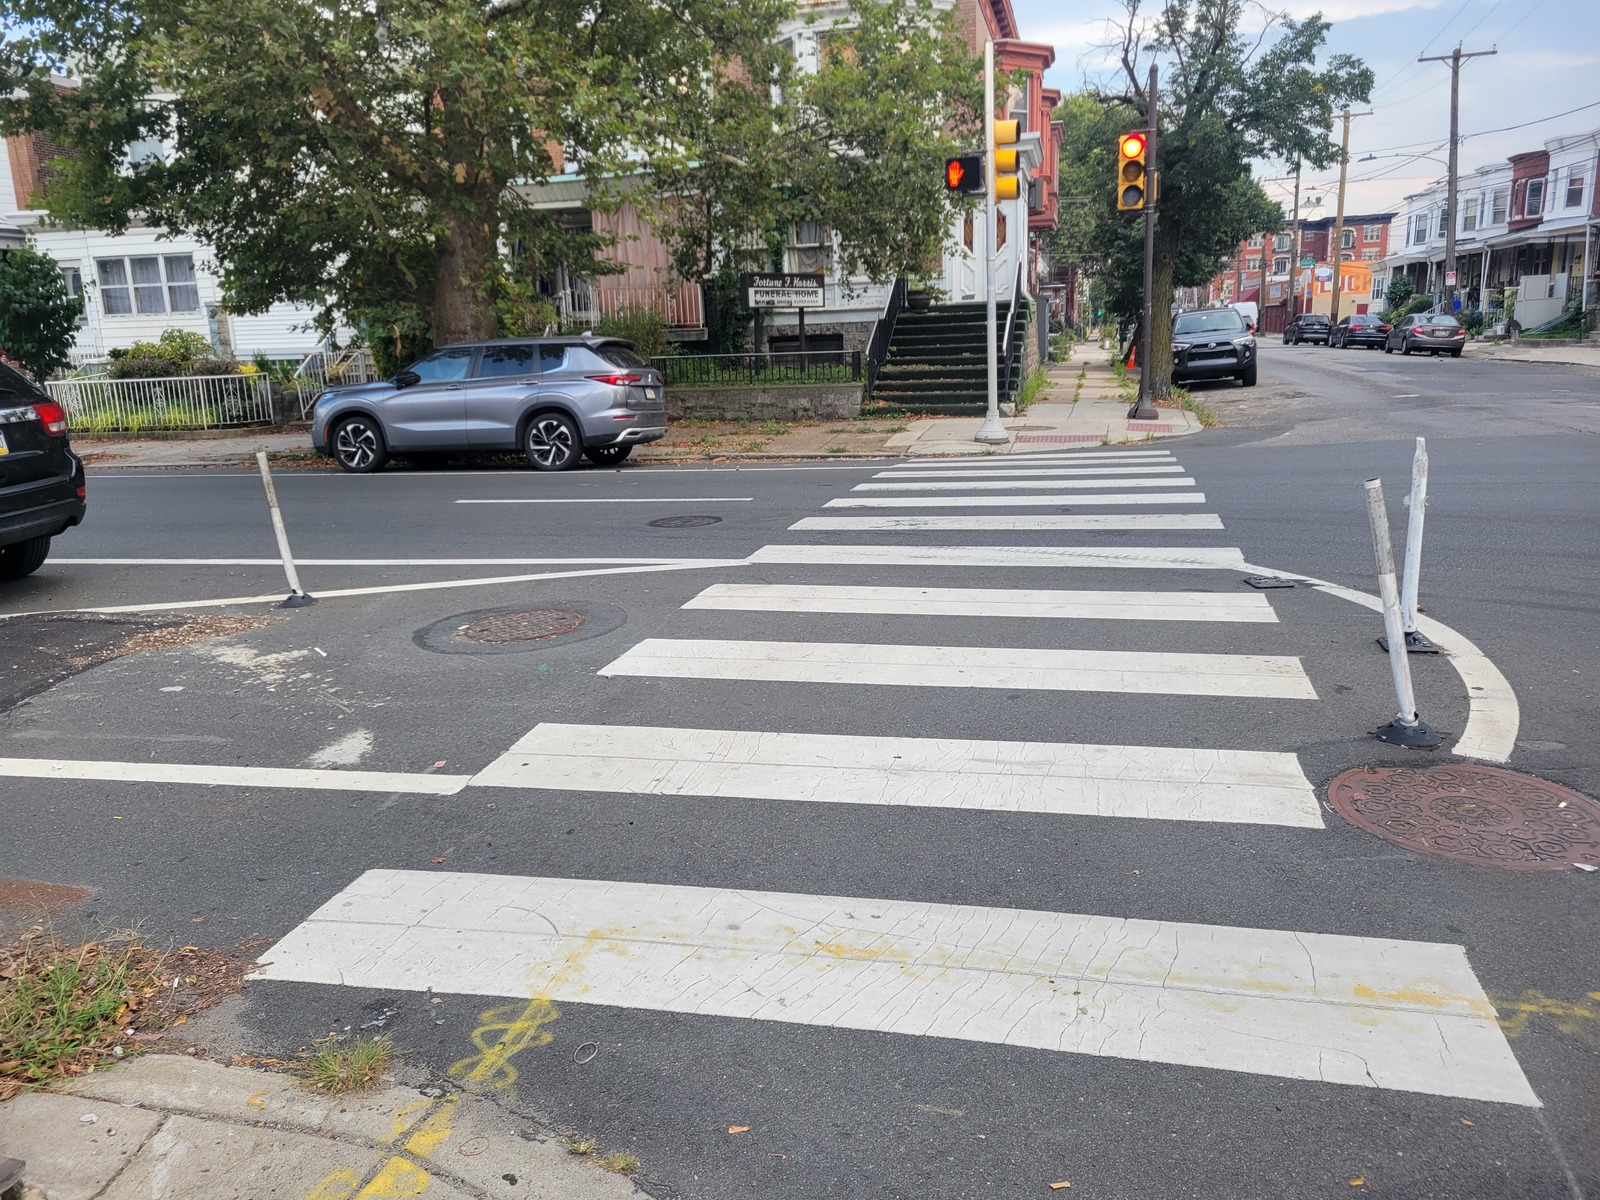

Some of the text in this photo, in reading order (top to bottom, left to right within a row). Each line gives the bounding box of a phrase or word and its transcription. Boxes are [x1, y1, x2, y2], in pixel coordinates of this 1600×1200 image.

[753, 276, 782, 287] Fortune
[754, 290, 819, 298] FUNERAL HOME
